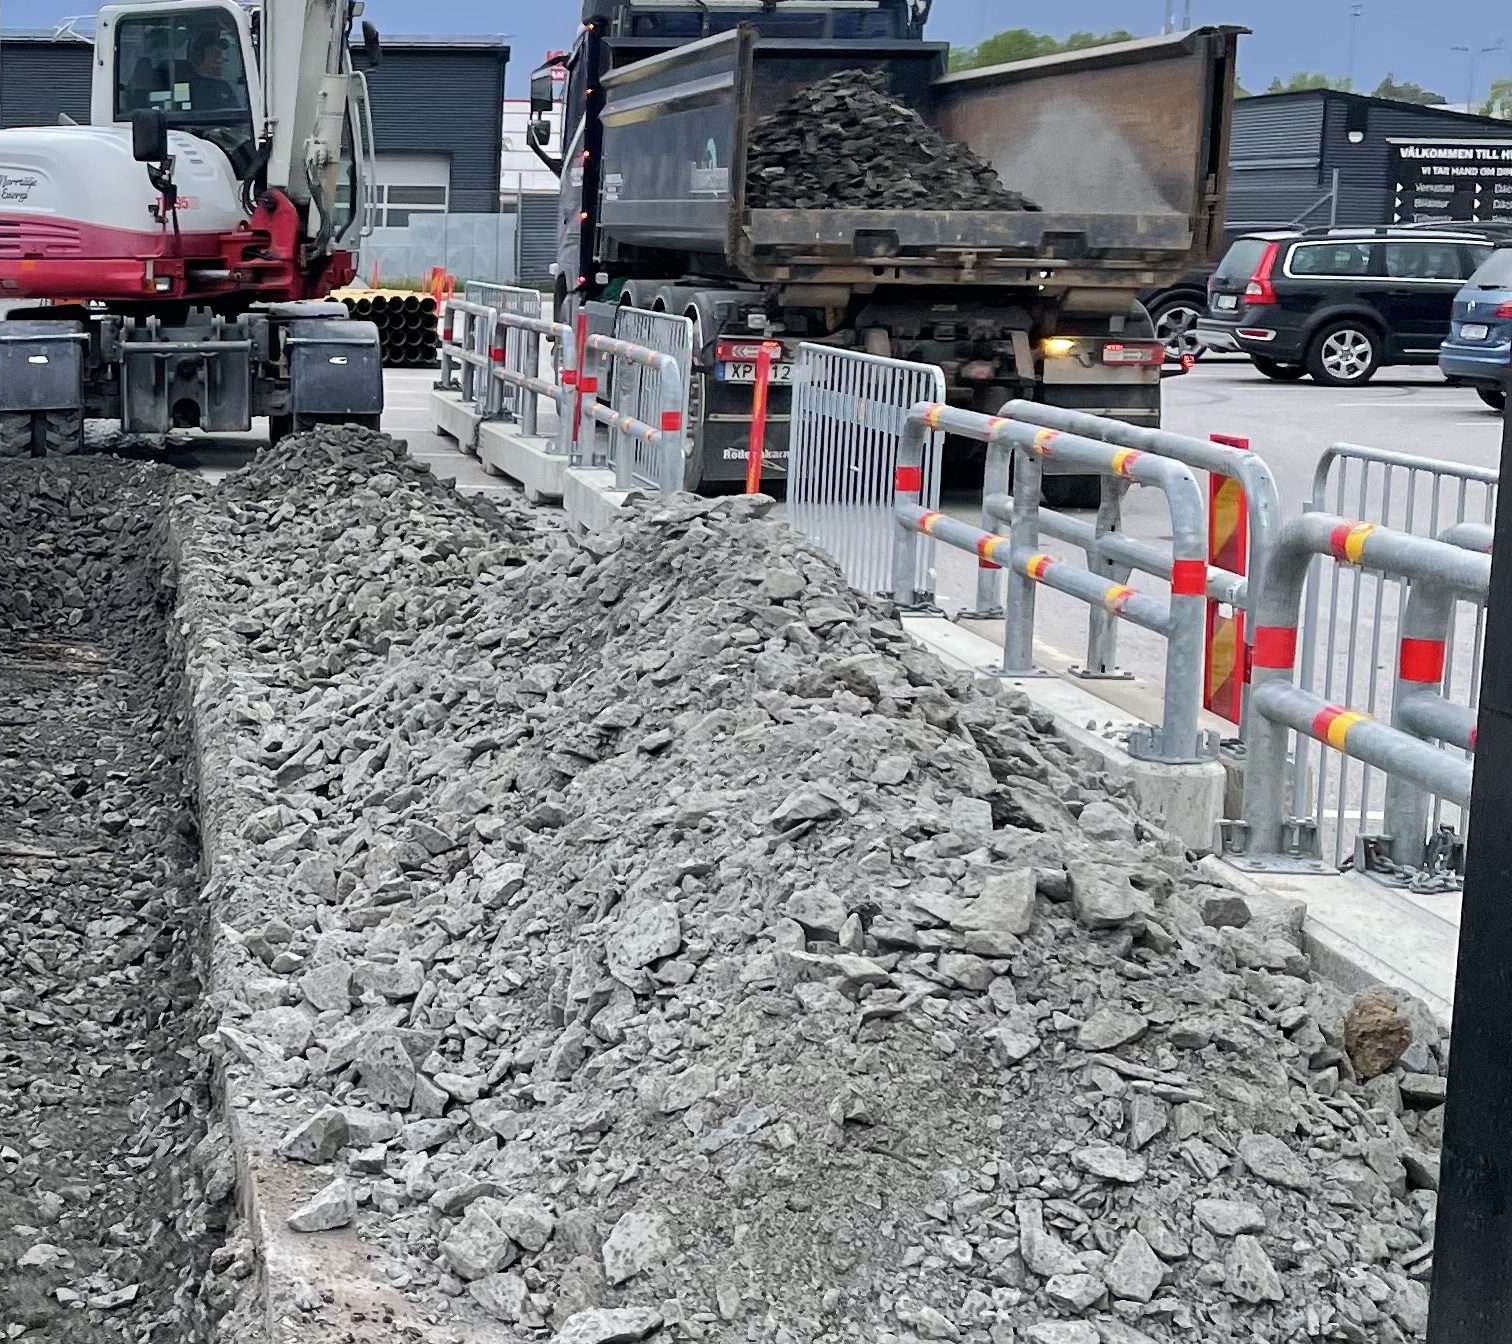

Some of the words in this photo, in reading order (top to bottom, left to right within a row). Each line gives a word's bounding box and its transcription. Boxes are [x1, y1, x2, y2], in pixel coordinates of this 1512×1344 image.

[1399, 145, 1473, 159] VÄLKOMMEN
[1475, 148, 1499, 160] TILL
[731, 363, 755, 379] XP
